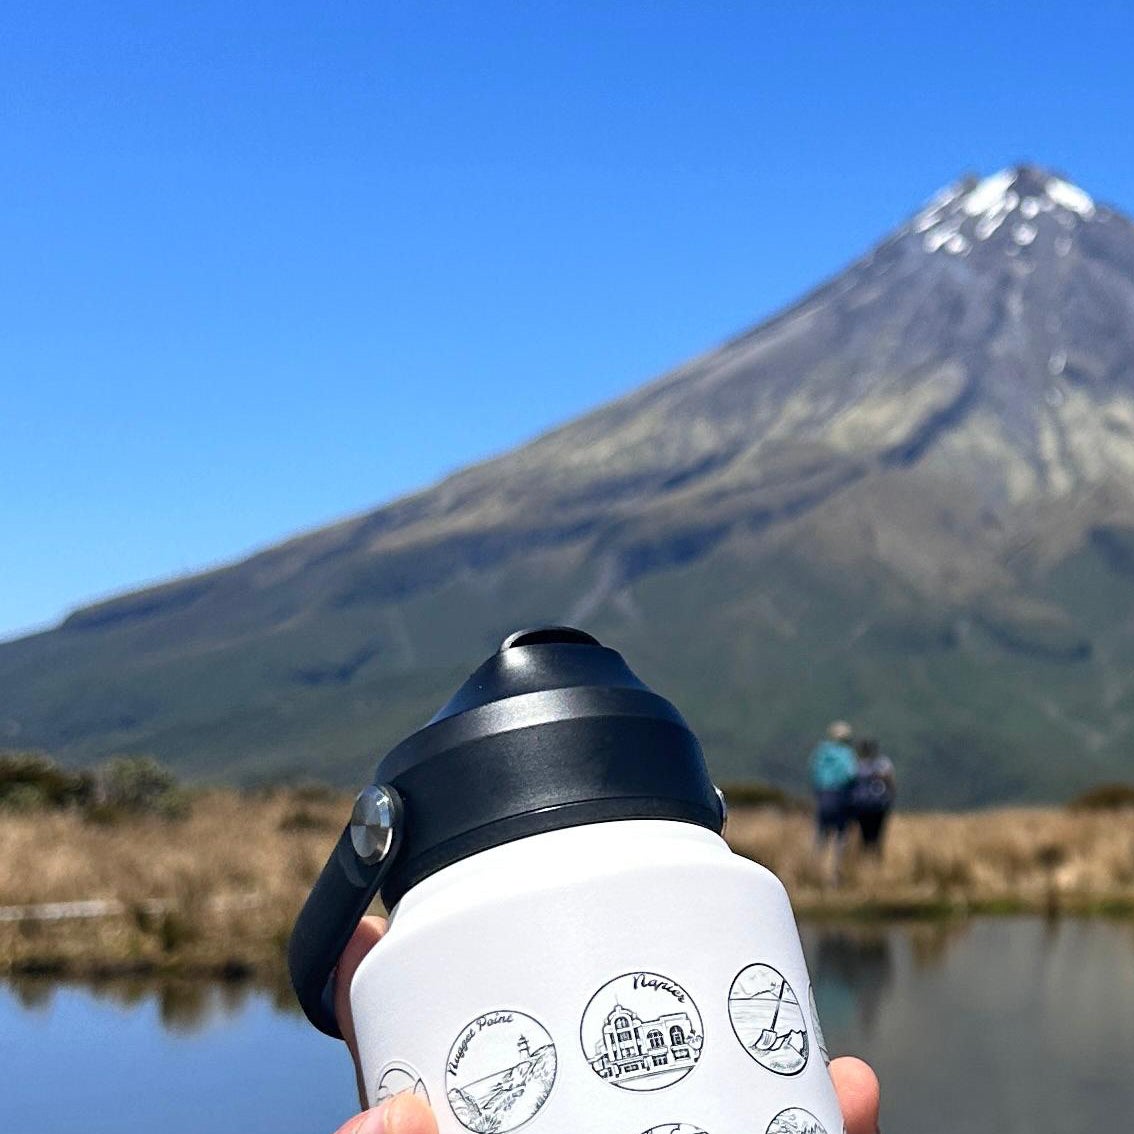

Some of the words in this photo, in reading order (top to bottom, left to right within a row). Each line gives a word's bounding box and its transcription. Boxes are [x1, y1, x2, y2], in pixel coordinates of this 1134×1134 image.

[633, 973, 686, 1003] Napier
[446, 1028, 476, 1076] Nugget
[476, 1012, 514, 1031] Point
